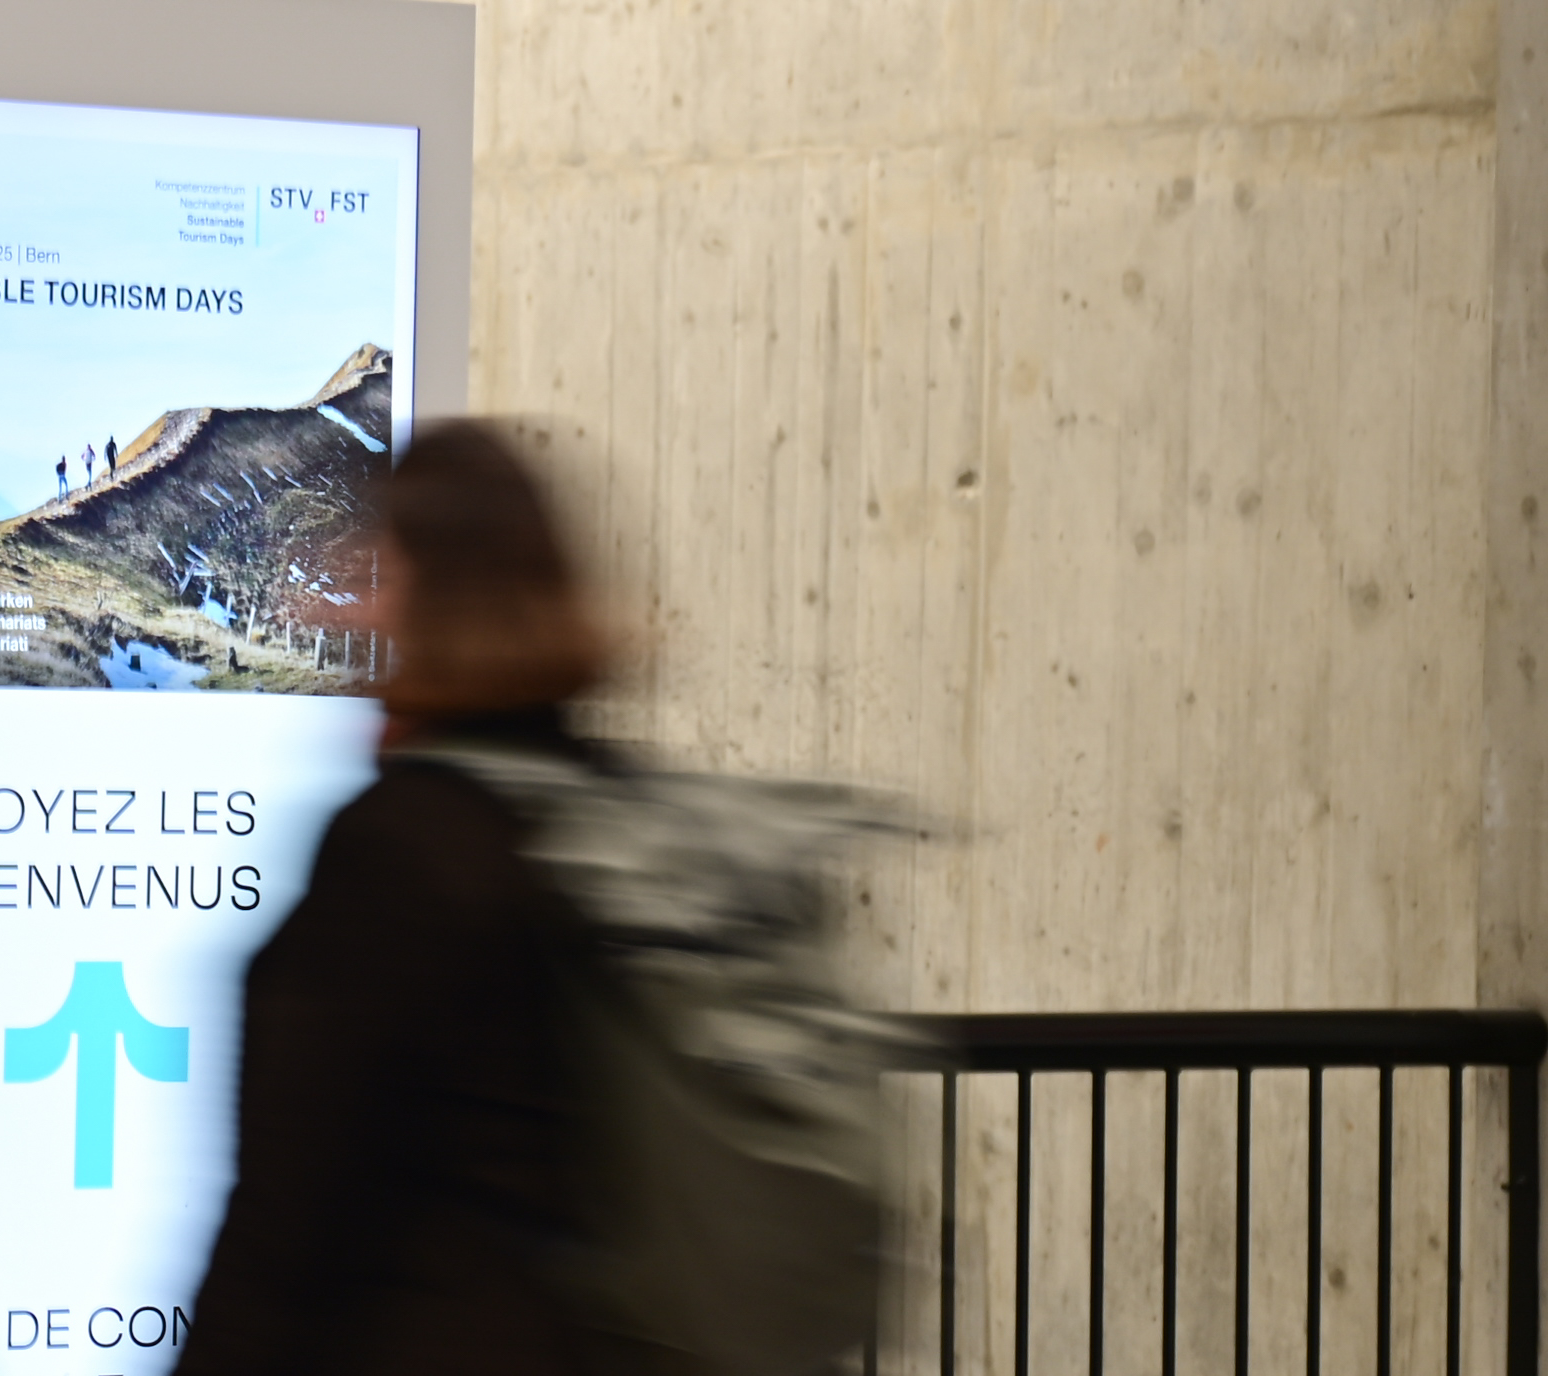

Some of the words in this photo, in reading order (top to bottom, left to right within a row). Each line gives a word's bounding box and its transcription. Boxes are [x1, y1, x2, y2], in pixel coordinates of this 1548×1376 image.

[155, 180, 245, 195] Kompetenzzentrum
[179, 197, 245, 212] Nachhaltigkeit
[270, 187, 313, 210] STV
[331, 191, 369, 213] FST
[187, 214, 245, 228] Sustainable
[178, 230, 217, 243] Tourism
[219, 233, 244, 247] Days
[26, 247, 60, 264] Bern
[44, 281, 166, 311] TOURISM
[176, 287, 244, 315] DAYS
[161, 790, 256, 836] LES
[8, 1309, 70, 1351] DE
